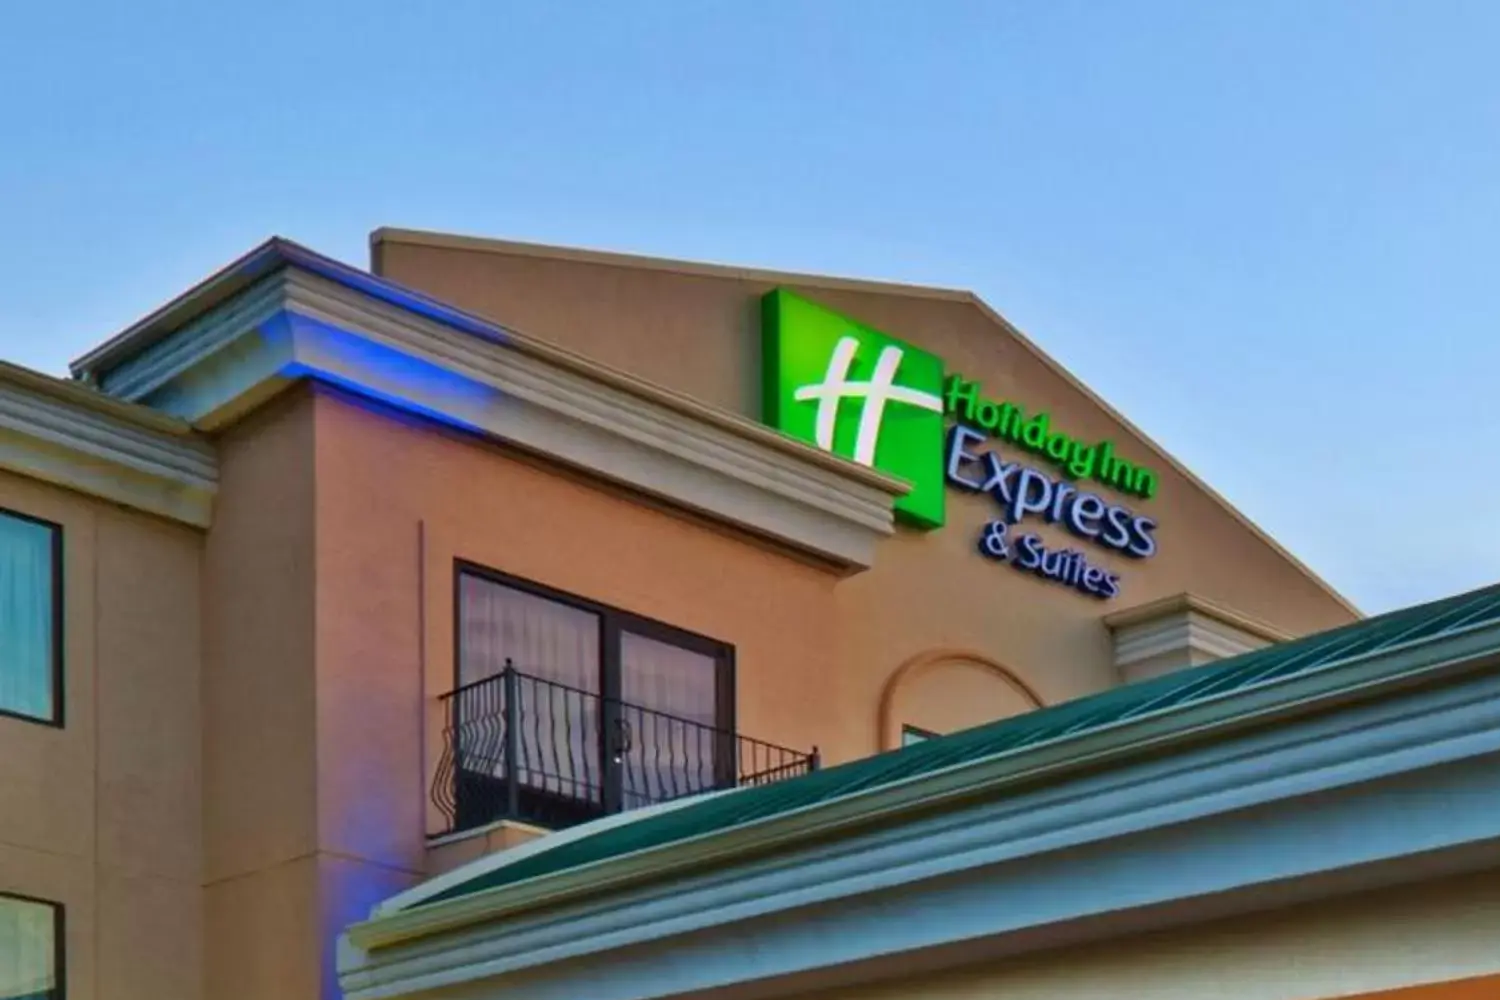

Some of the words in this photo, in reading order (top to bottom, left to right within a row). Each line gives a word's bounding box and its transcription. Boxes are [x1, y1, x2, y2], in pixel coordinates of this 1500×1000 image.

[945, 374, 1095, 479] Holiday
[1099, 440, 1158, 498] Inn
[946, 424, 1157, 558] Express
[981, 519, 1010, 558] &
[1018, 533, 1121, 598] Suites
